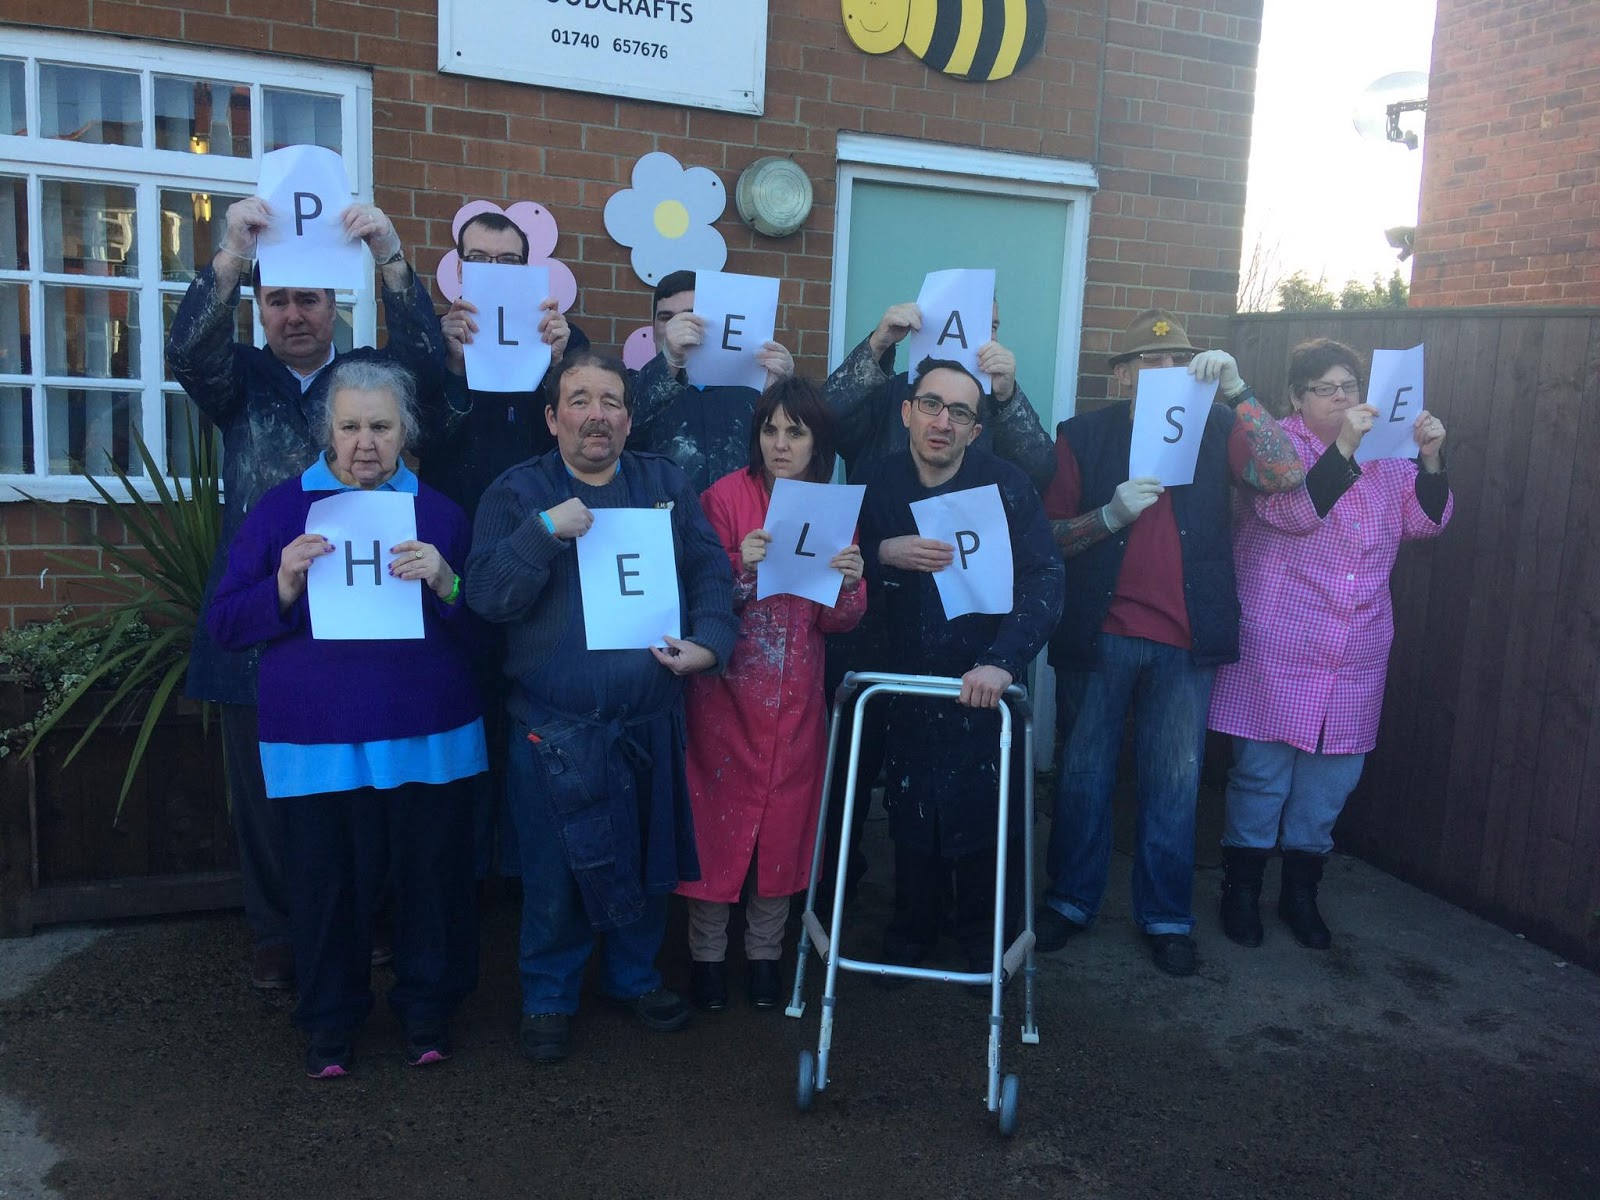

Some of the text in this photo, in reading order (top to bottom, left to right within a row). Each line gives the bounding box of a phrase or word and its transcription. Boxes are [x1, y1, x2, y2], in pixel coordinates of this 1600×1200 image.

[551, 28, 668, 60] 01740 657676
[293, 191, 323, 237] P
[497, 305, 519, 346] L
[721, 313, 746, 352] E
[936, 310, 968, 350] A
[1163, 405, 1186, 444] S
[1388, 386, 1413, 423] E
[794, 522, 816, 558] L
[954, 530, 981, 570] P
[344, 539, 382, 587] H
[616, 553, 645, 597] E
